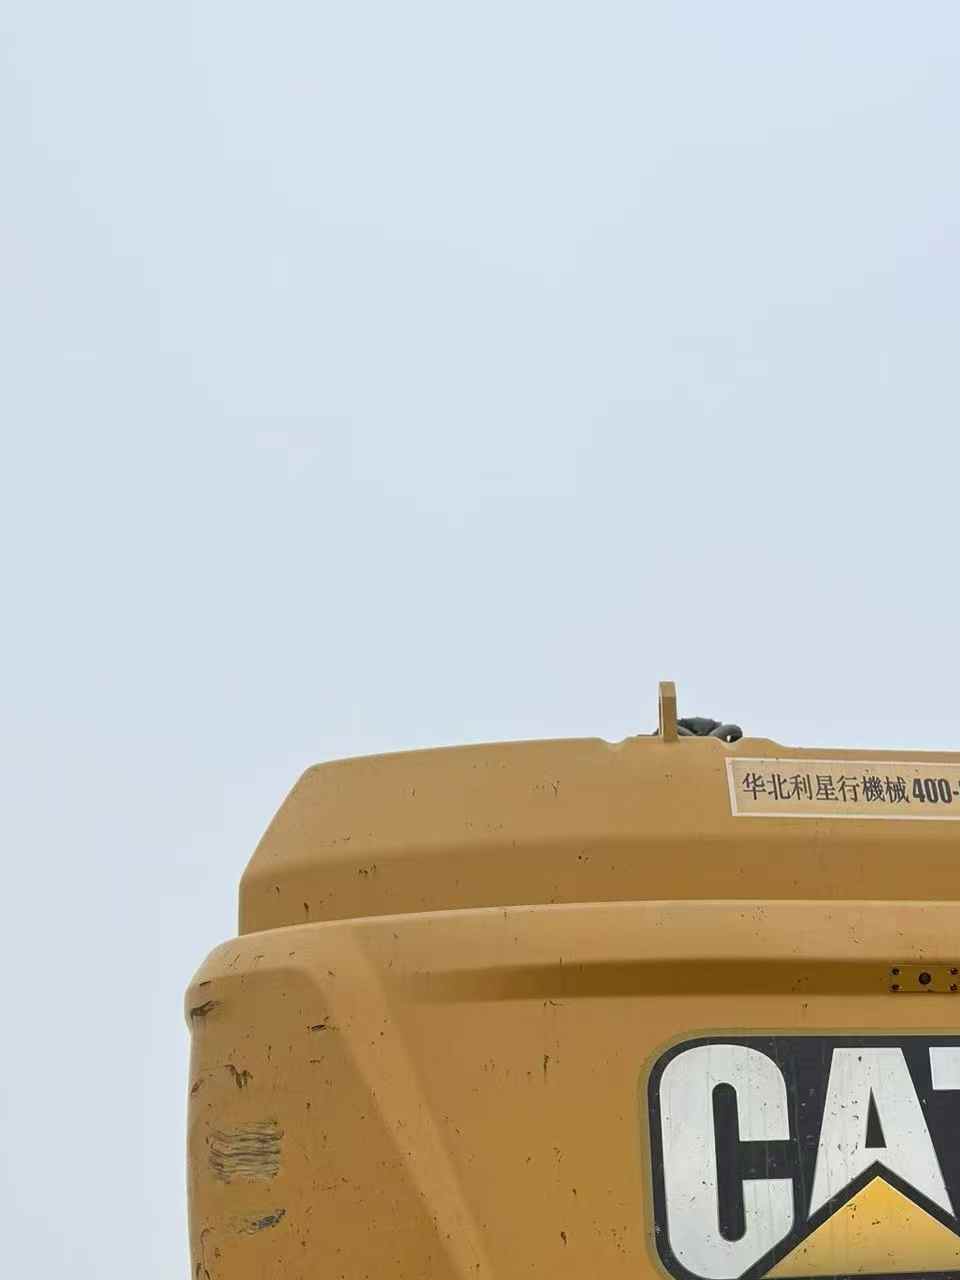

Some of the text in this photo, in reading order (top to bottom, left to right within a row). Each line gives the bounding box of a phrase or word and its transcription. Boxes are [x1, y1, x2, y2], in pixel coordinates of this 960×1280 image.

[742, 772, 910, 804] 华北利星行機械
